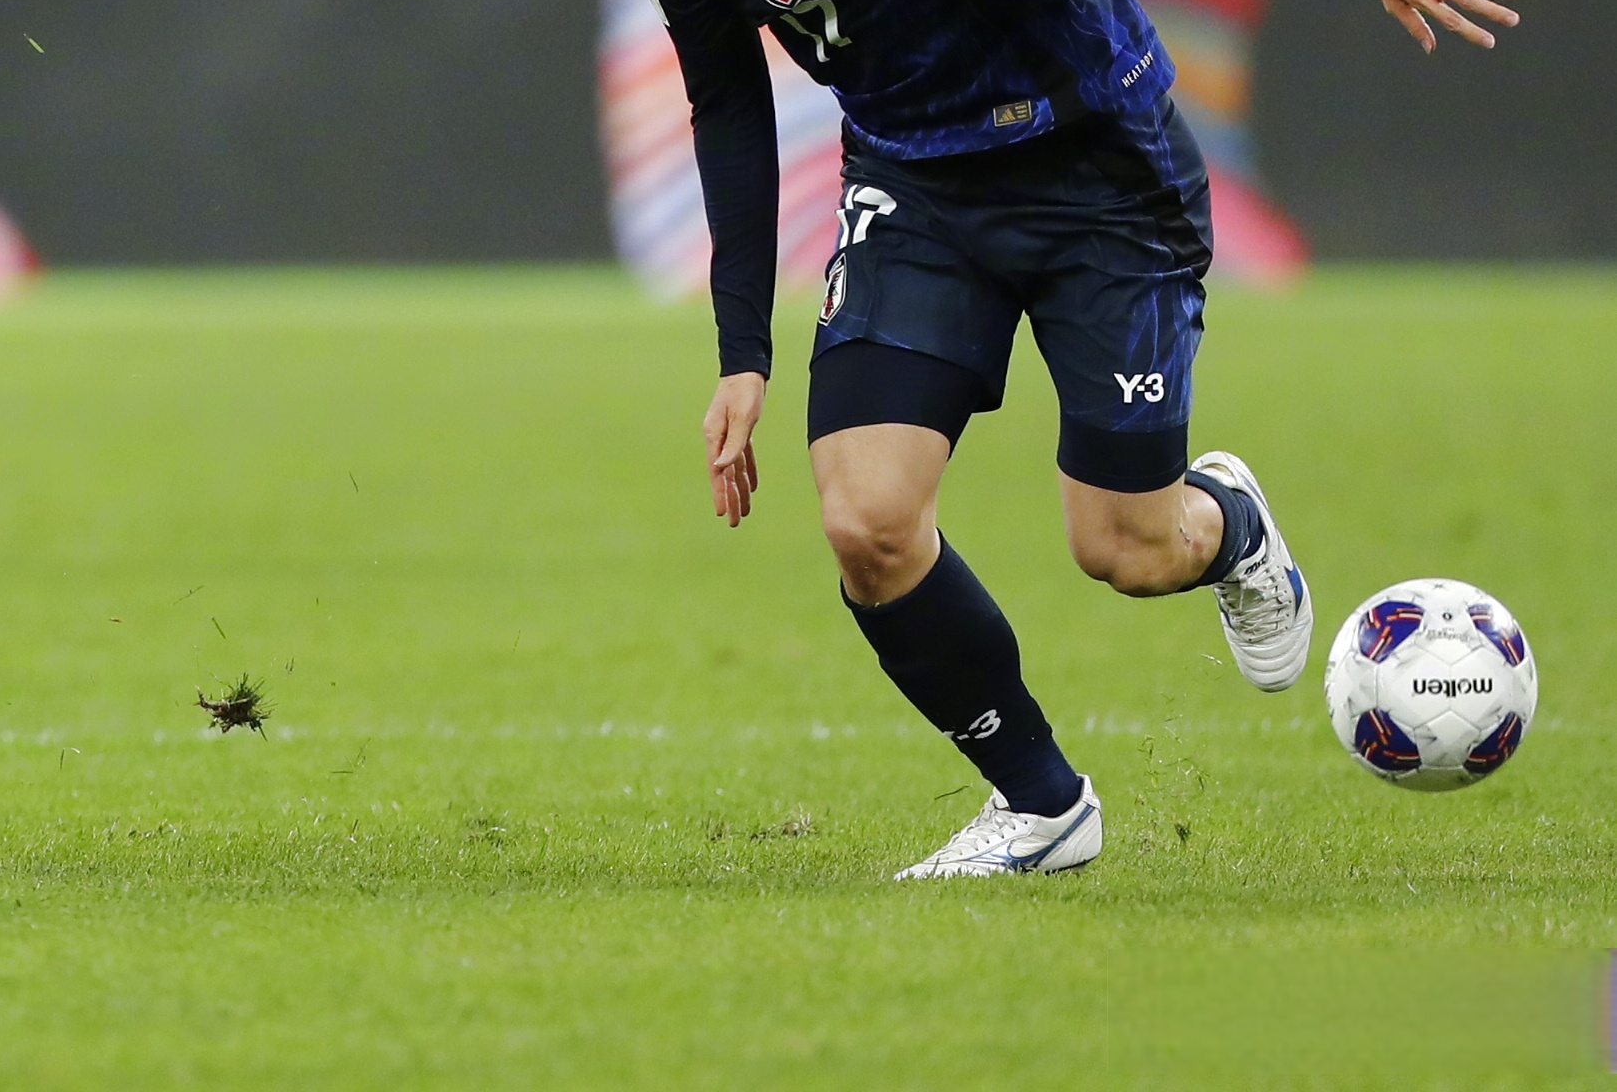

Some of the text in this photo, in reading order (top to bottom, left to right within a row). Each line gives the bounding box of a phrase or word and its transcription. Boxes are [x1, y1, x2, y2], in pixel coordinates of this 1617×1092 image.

[1121, 50, 1154, 88] HEAT.RDY
[835, 184, 897, 249] 17
[1114, 373, 1164, 403] Y-3
[1413, 678, 1493, 697] molten
